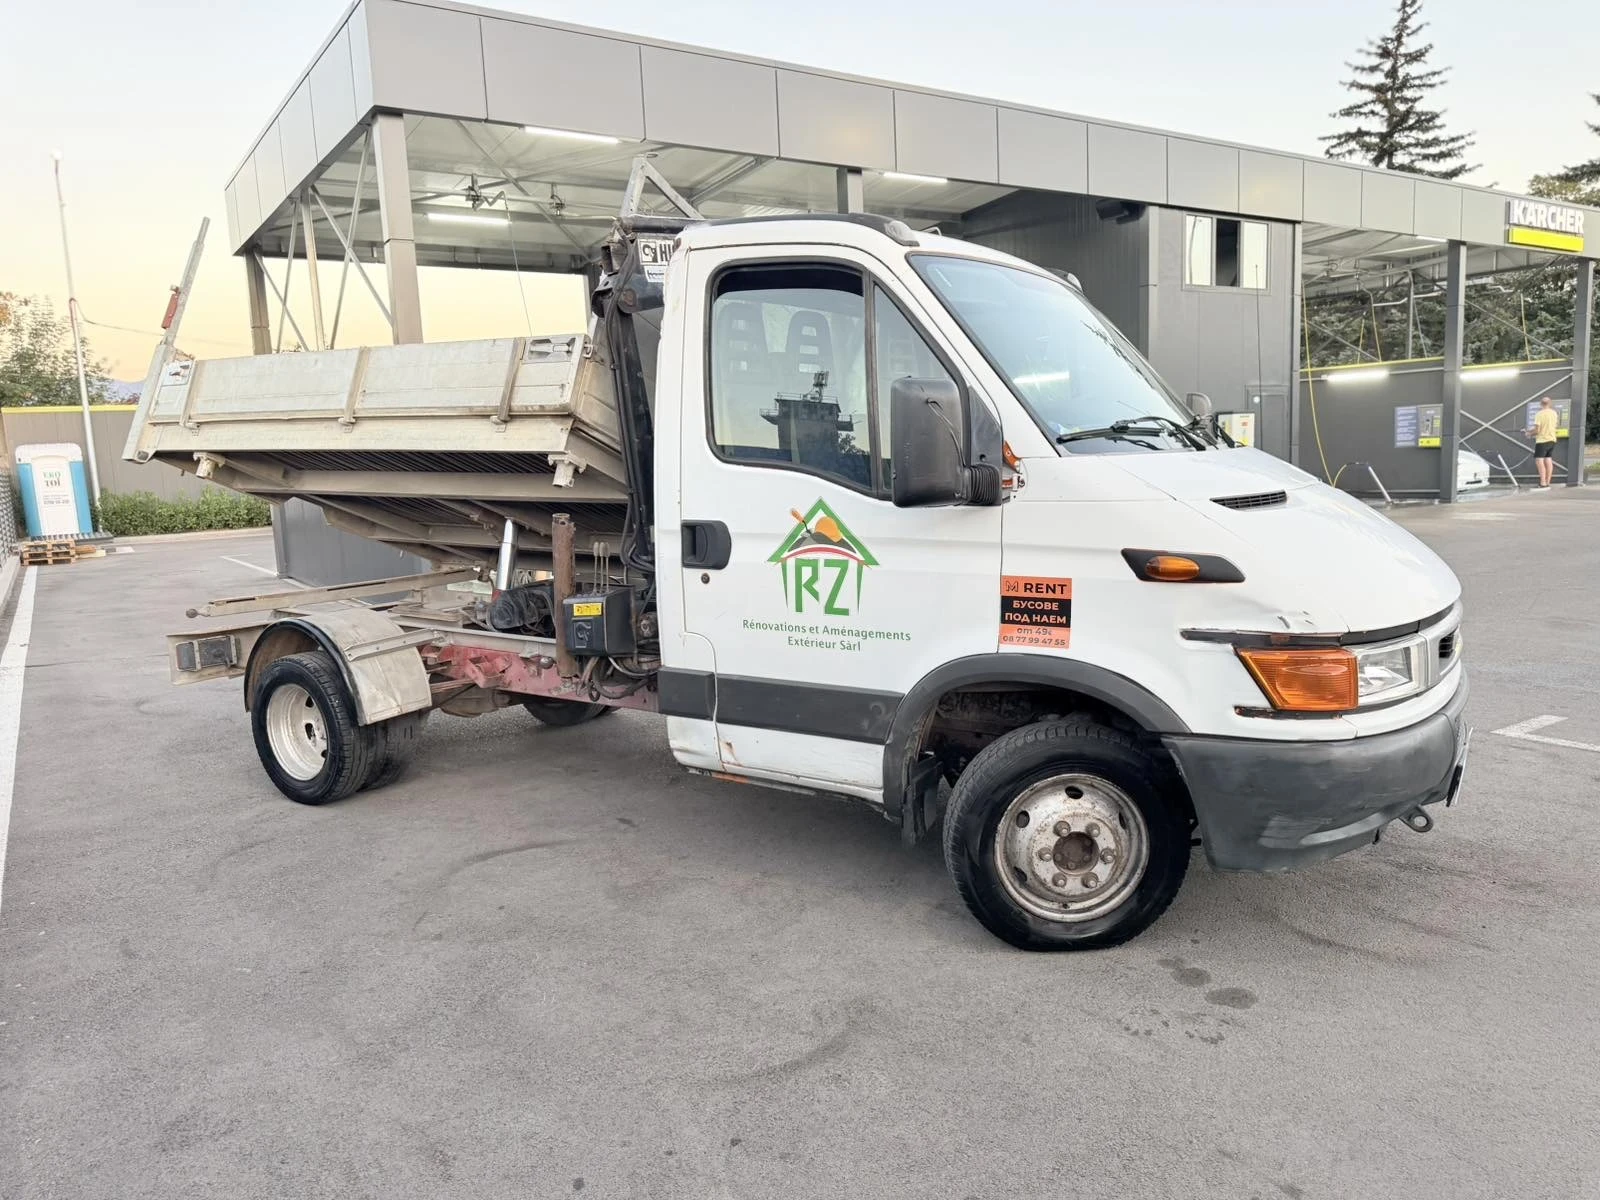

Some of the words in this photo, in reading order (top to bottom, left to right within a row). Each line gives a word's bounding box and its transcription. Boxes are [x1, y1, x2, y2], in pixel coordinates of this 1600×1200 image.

[794, 558, 850, 616] RZ
[1024, 583, 1067, 594] RENT
[1013, 600, 1059, 610] БУСОВЕ
[1005, 612, 1030, 623] ПОД
[1032, 614, 1066, 624] НАЕМ
[742, 619, 807, 634] Rénovations
[808, 626, 820, 634] et
[822, 625, 912, 642] Aménagements
[787, 636, 837, 650] Extérieur
